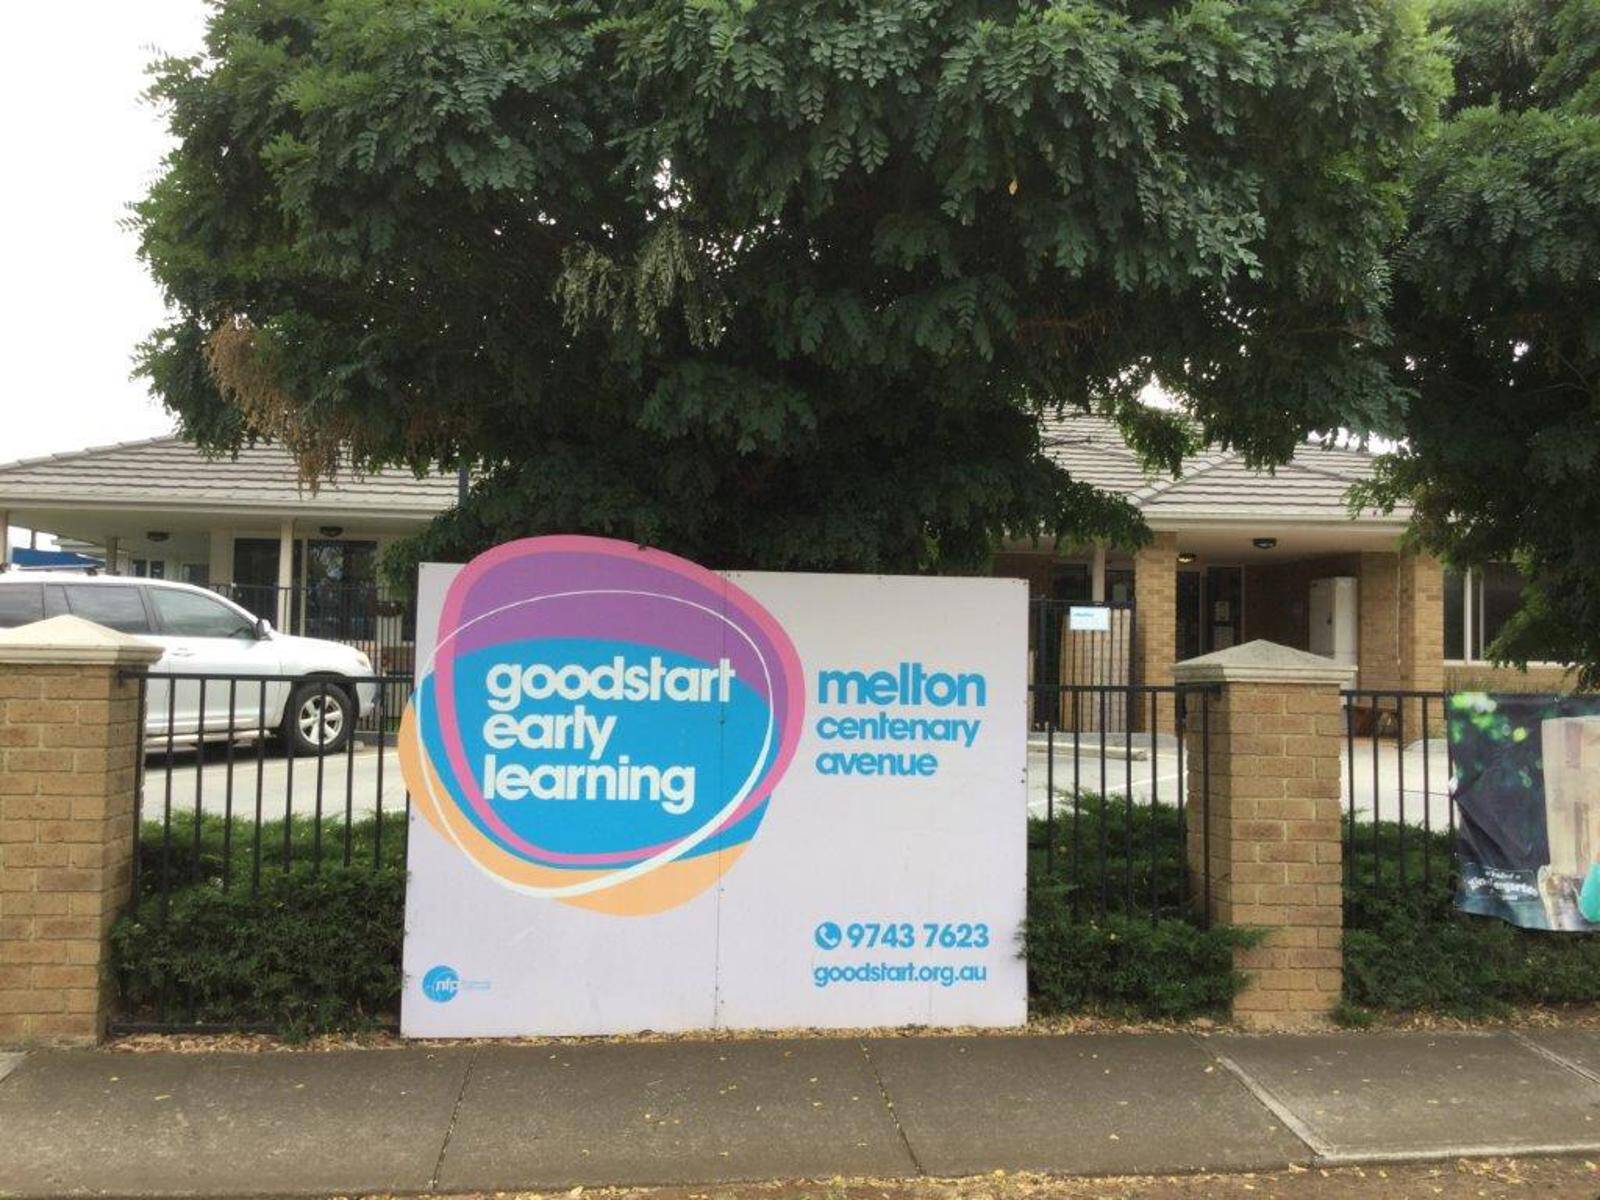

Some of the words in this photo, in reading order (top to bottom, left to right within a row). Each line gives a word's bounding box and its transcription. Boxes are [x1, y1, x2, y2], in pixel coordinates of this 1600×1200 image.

[486, 656, 736, 711] goodstart
[818, 662, 987, 707] melton
[483, 705, 617, 760] early
[816, 711, 981, 748] centenary
[483, 754, 696, 815] learning
[815, 752, 938, 776] avenue
[847, 923, 915, 949] 9743
[923, 923, 989, 949] 7623
[814, 963, 987, 987] goodstart.org.au
